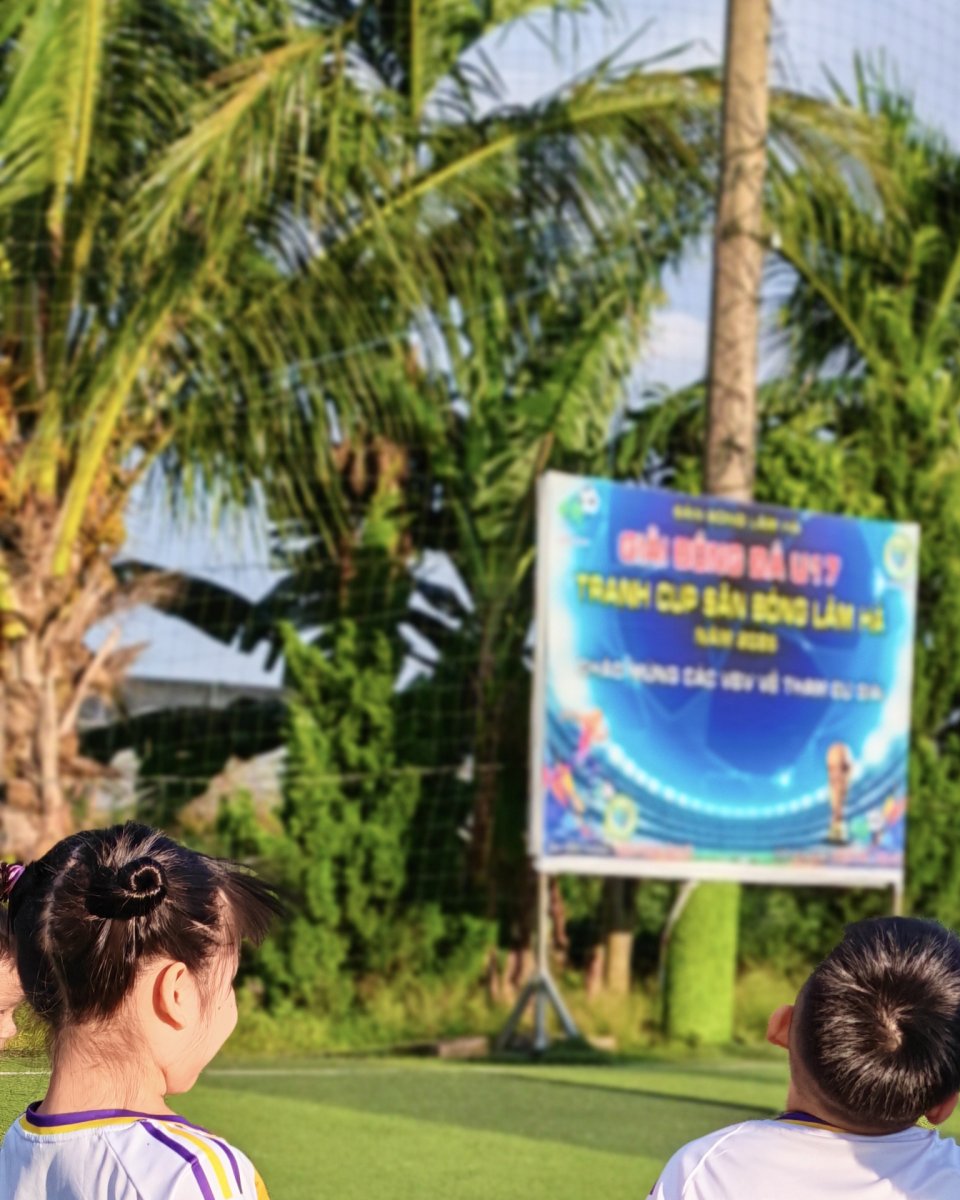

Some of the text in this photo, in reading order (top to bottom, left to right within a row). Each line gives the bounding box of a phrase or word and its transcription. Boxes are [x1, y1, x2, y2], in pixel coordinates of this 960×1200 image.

[673, 529, 744, 578] BÓNG
[789, 550, 842, 588] U17
[576, 572, 651, 610] TRANH
[656, 580, 699, 614] CUP
[752, 586, 808, 630] BÓNG
